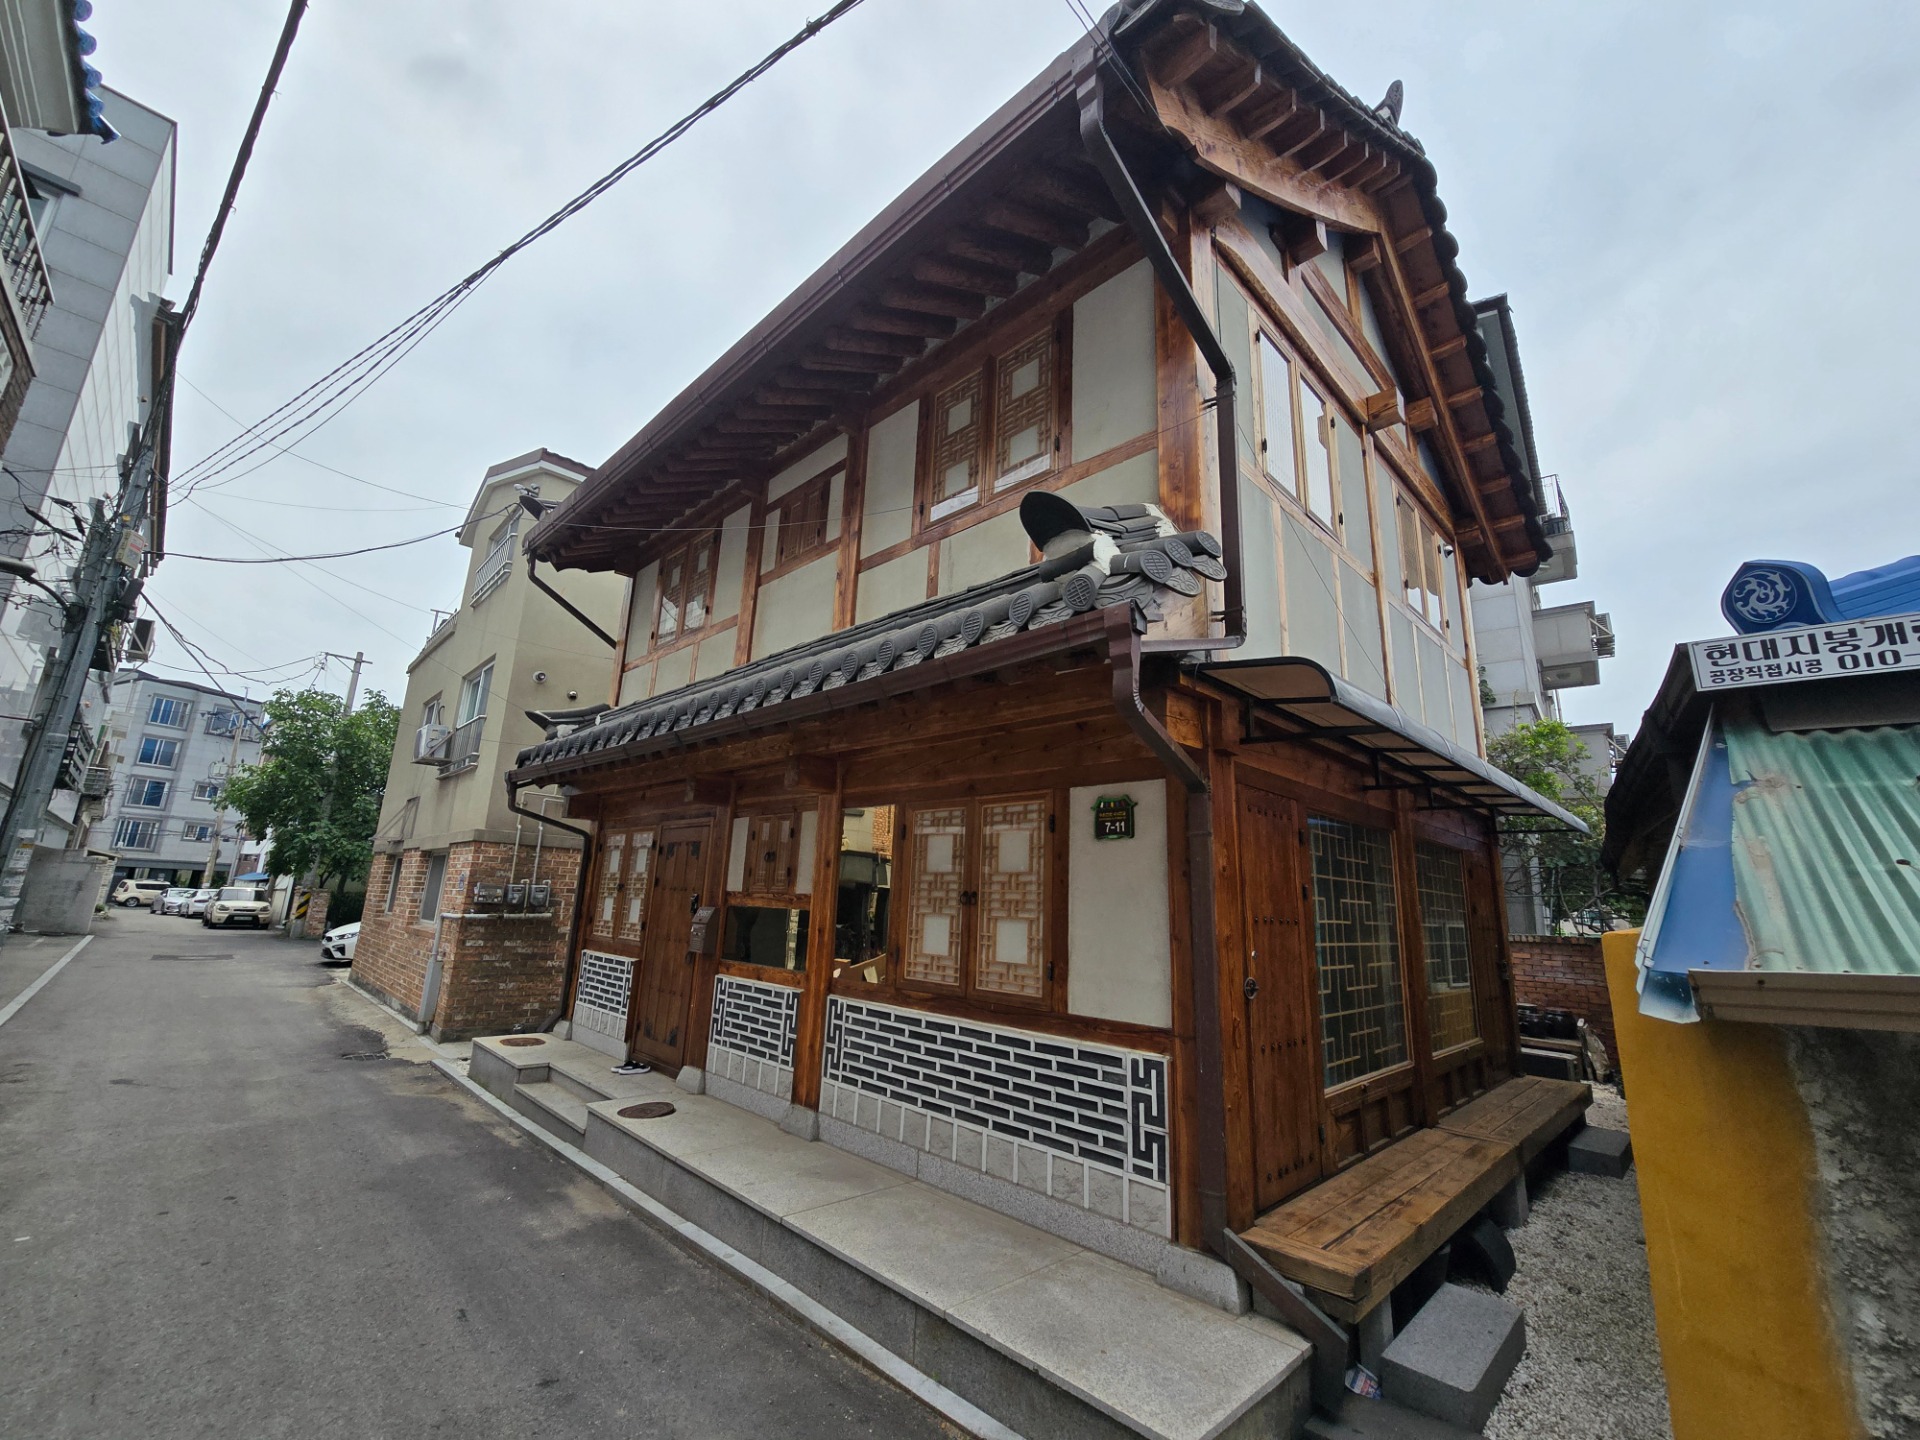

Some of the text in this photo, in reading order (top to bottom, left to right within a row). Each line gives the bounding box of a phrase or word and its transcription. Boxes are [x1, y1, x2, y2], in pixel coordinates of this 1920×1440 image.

[1703, 618, 1920, 667] 현대지붕개
[1709, 658, 1823, 684] 공장직접시공
[1105, 821, 1125, 833] 7-11
